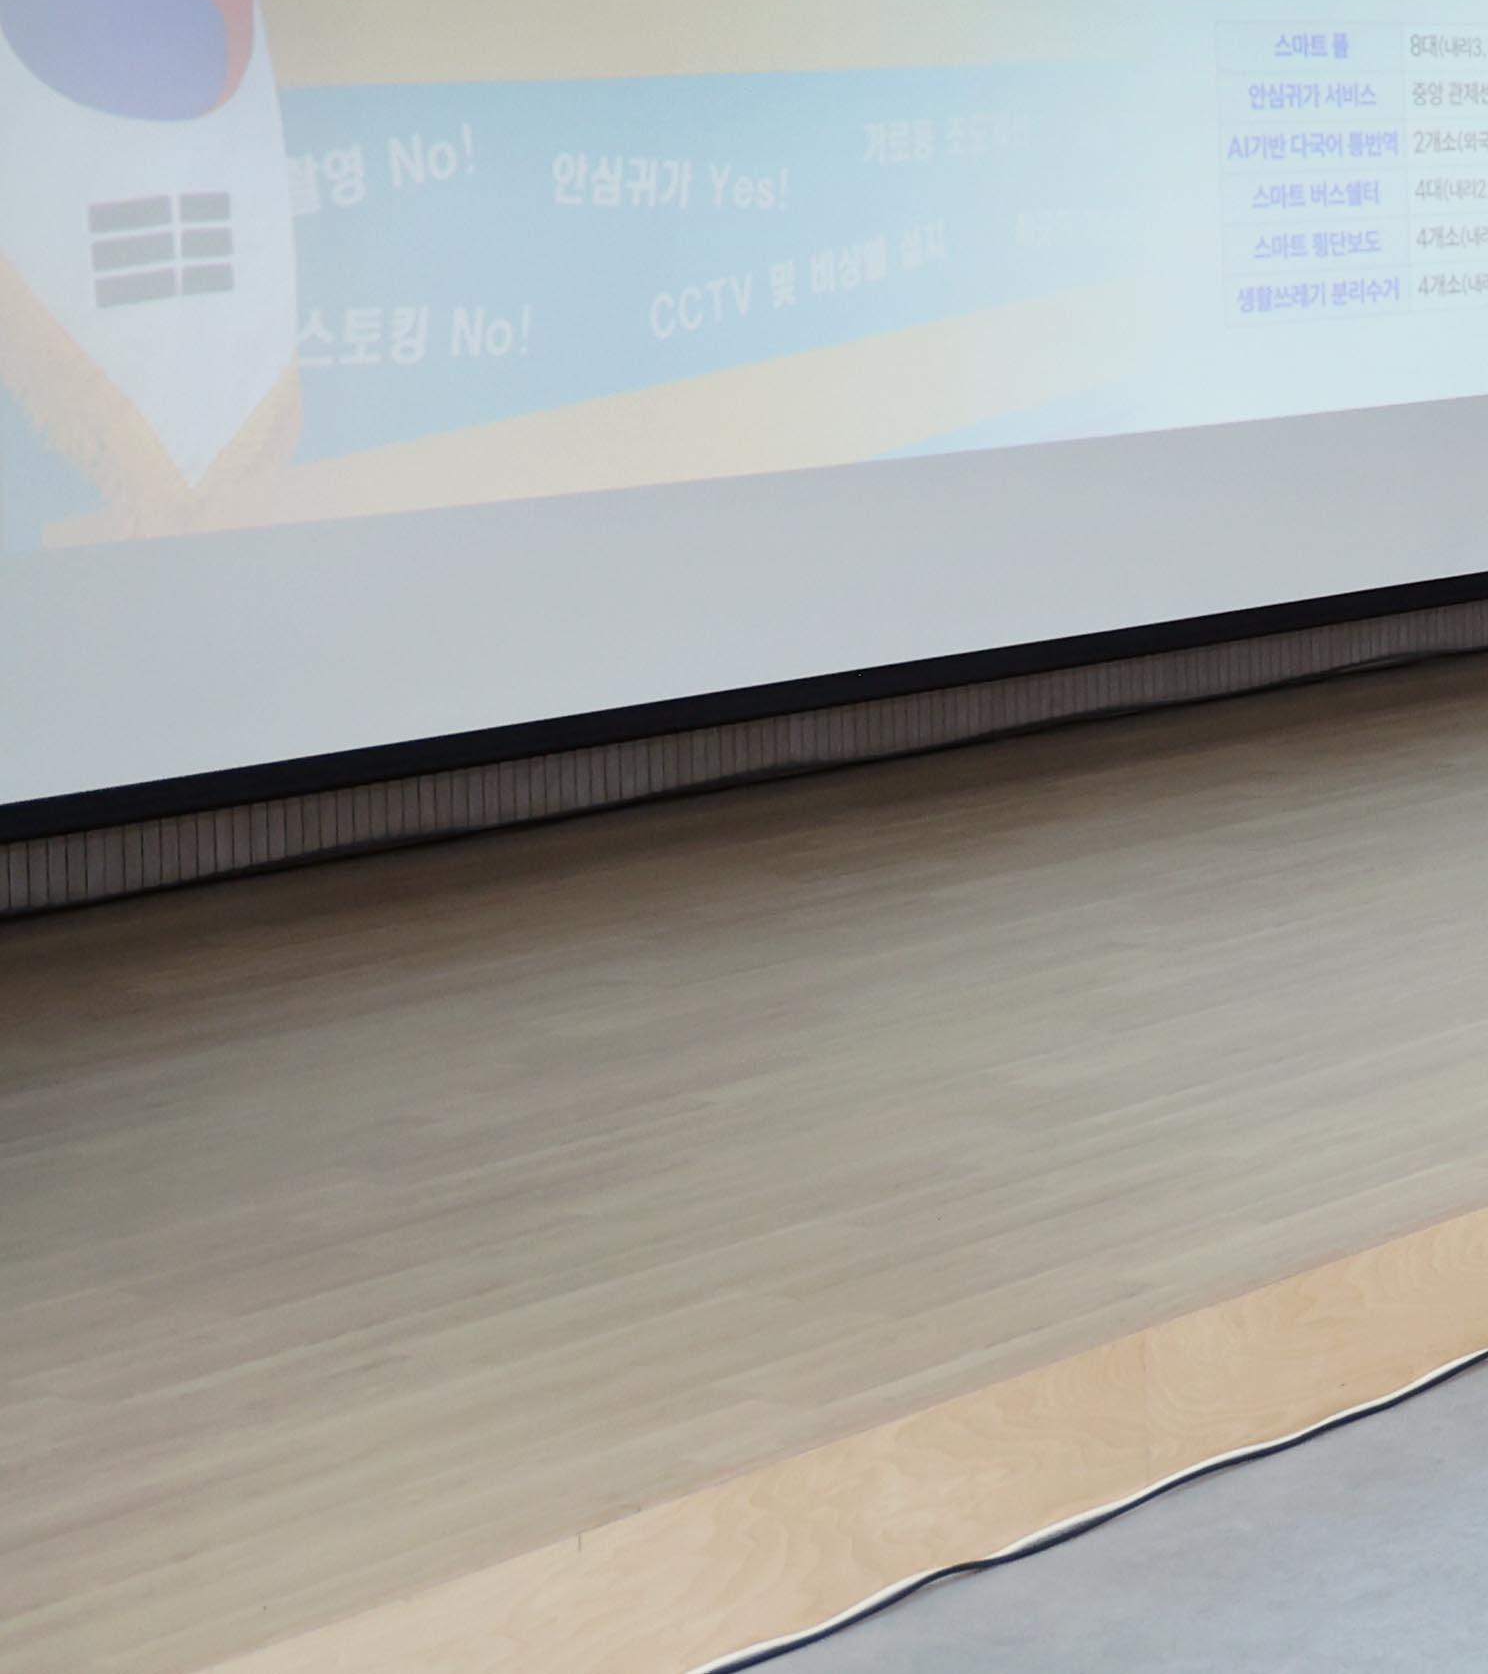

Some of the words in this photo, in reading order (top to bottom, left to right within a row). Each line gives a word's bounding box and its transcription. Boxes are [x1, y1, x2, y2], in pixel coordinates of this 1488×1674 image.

[1273, 32, 1329, 59] 스마트
[1248, 81, 1321, 111] 안심귀가
[1324, 81, 1378, 109] 서비스
[387, 122, 476, 189] No!
[1226, 132, 1287, 161] AI기반
[1289, 131, 1344, 159] 다국어
[551, 151, 693, 209] 안심귀가
[709, 163, 790, 211] Yes!
[1251, 183, 1307, 210] 스마트
[1253, 232, 1309, 260] 스마트
[649, 271, 754, 341] CCTV
[298, 304, 430, 367] 스토킹
[450, 302, 533, 360] No!
